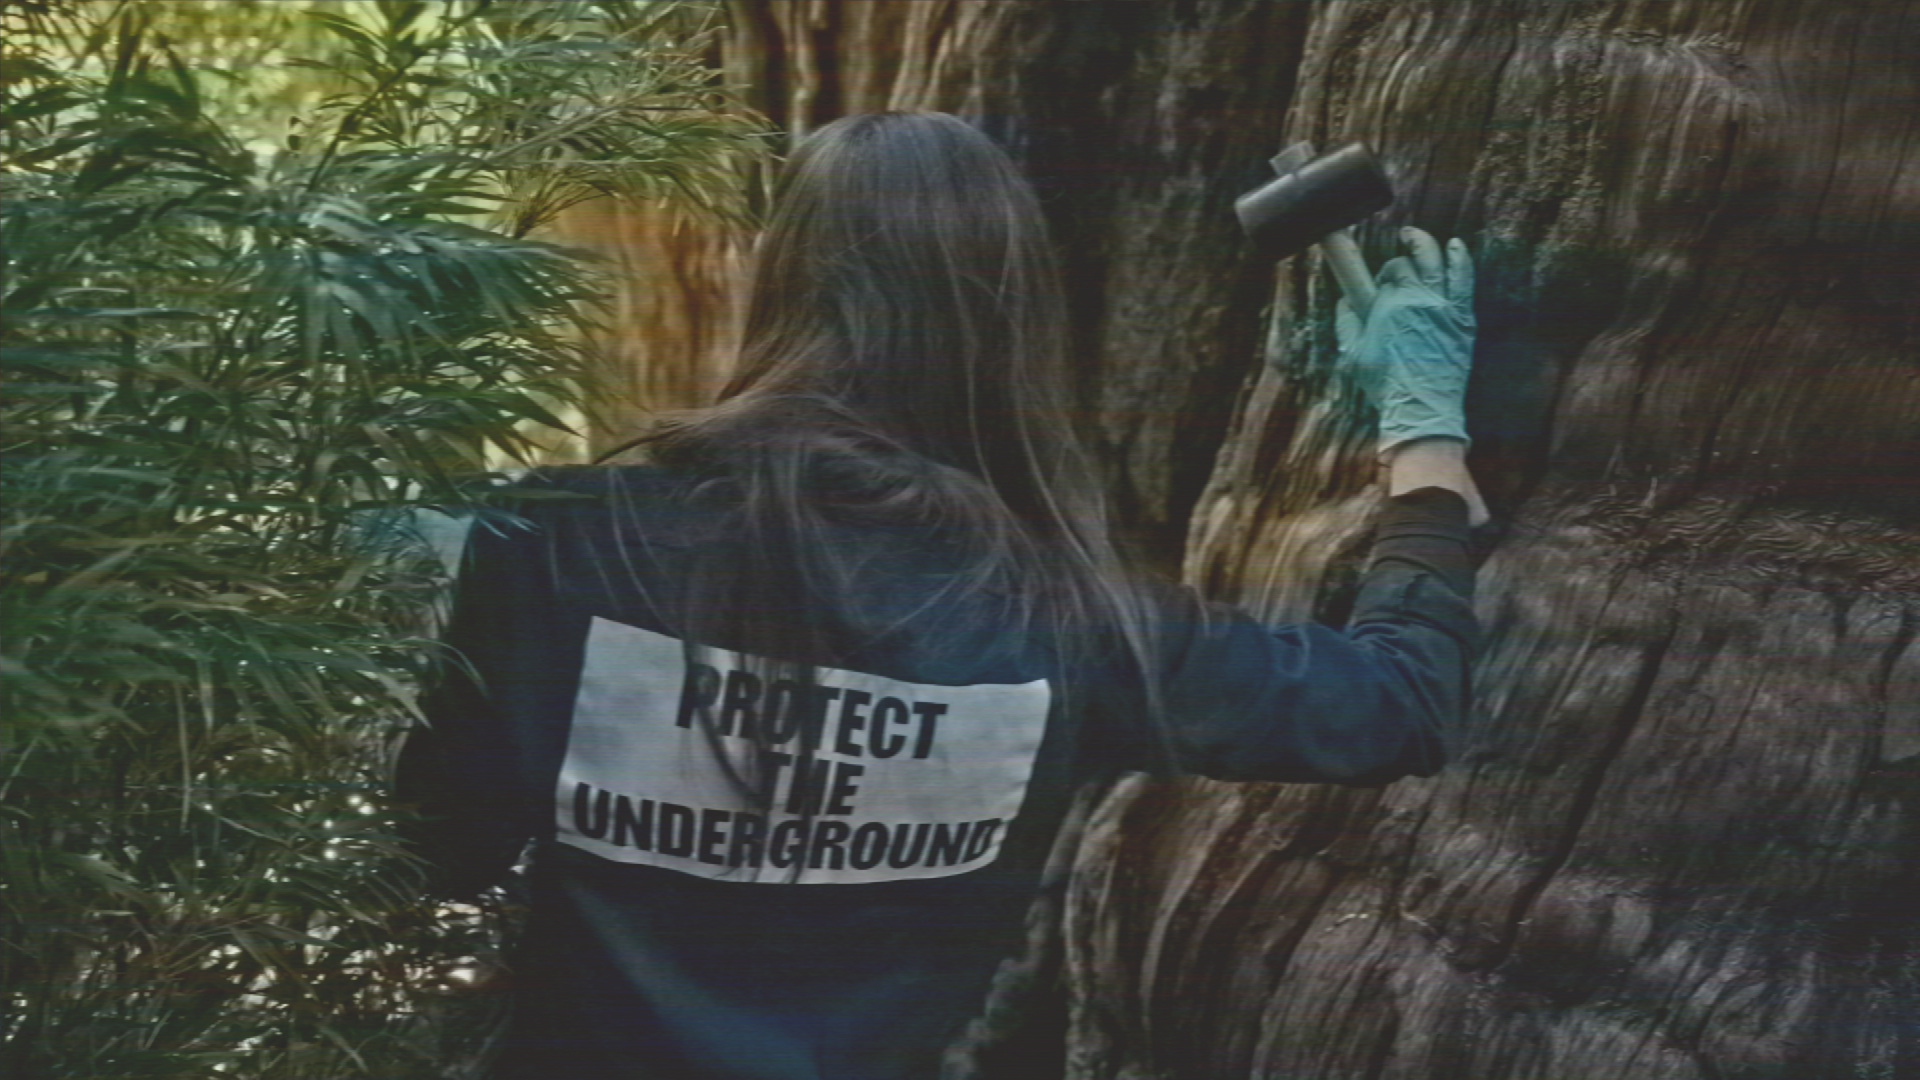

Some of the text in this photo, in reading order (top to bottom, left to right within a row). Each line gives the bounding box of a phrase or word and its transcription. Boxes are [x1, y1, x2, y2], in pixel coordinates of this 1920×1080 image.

[676, 663, 948, 759] PROTECT
[573, 782, 1004, 870] UNDERGROUND
[762, 751, 865, 816] THE
